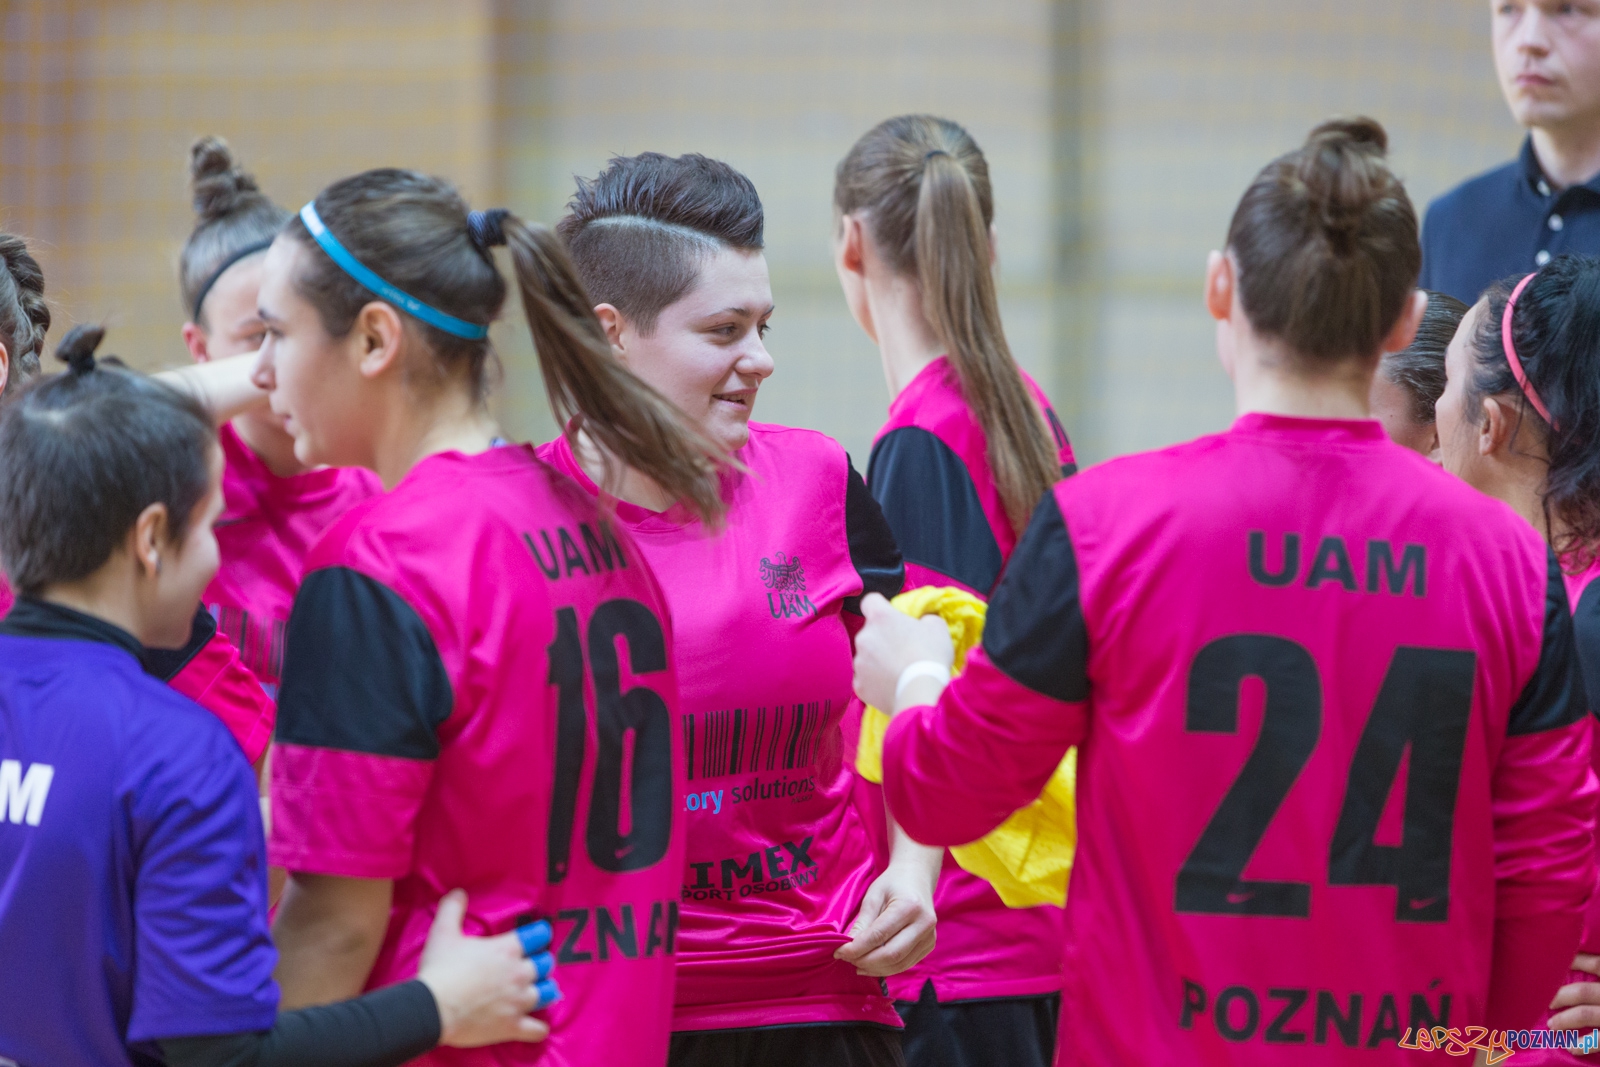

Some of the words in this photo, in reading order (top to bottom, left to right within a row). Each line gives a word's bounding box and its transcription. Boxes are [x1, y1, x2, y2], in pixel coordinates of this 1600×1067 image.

[523, 522, 628, 580] UAM
[1247, 530, 1427, 597] UAM
[766, 592, 818, 619] UAM
[547, 598, 671, 885] 16
[683, 789, 724, 815] ory
[731, 775, 816, 804] solutions
[1174, 632, 1477, 924] 24
[684, 835, 817, 889] IMEX
[739, 868, 819, 898] OSOBOWY
